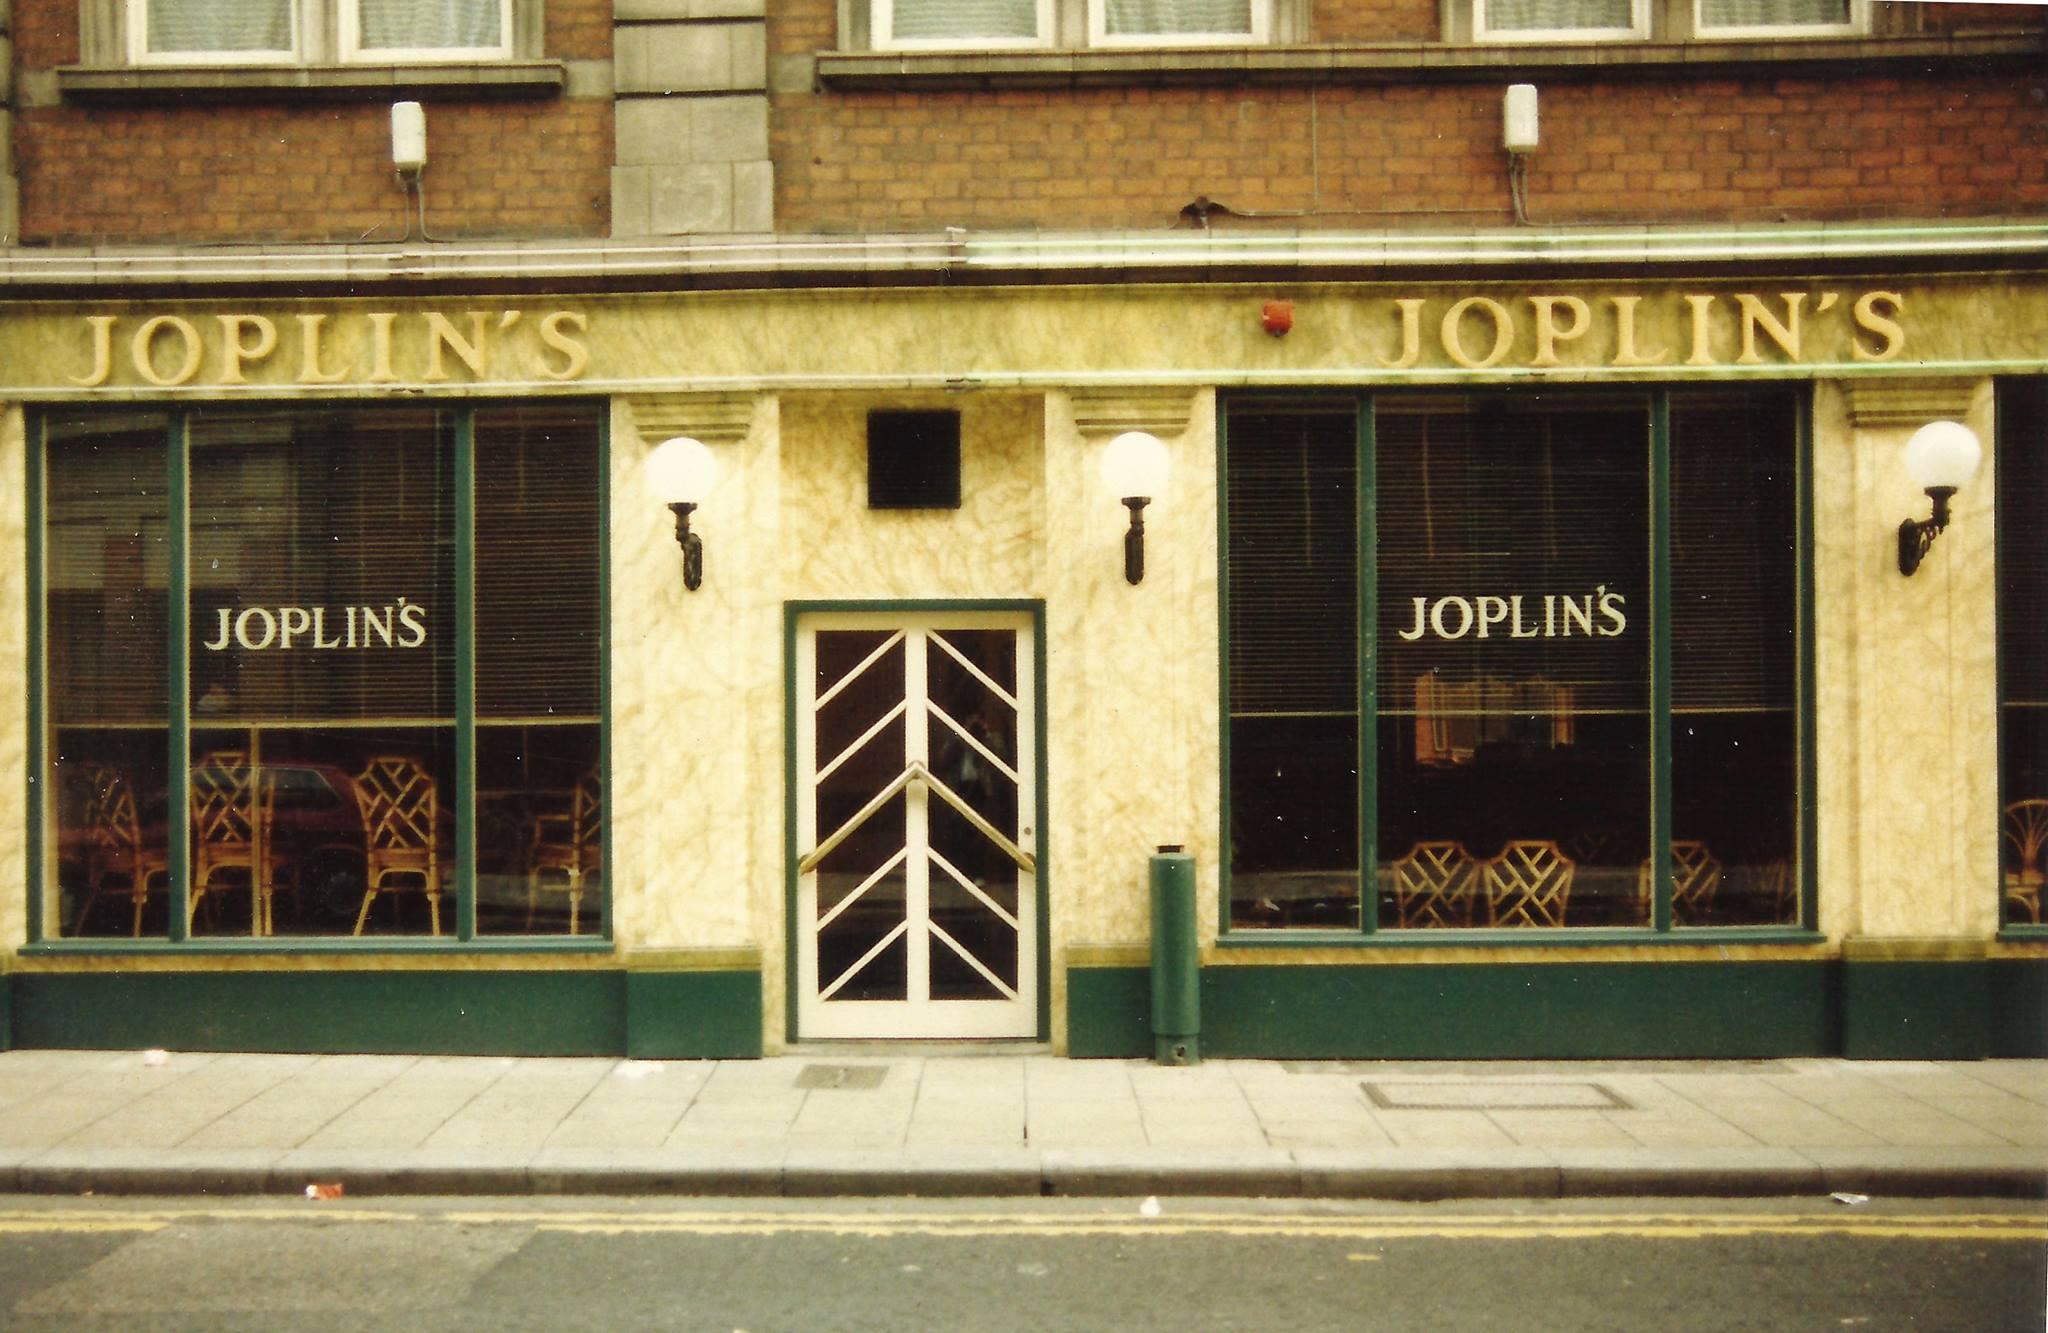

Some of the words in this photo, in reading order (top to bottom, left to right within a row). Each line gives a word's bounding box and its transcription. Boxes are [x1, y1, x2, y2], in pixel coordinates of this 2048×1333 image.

[69, 310, 588, 386] JOPLIN'S
[1377, 291, 1904, 368] JOPLIN'S
[204, 597, 426, 650] JOPLIN'S
[1399, 586, 1626, 640] JOPLIN'S
